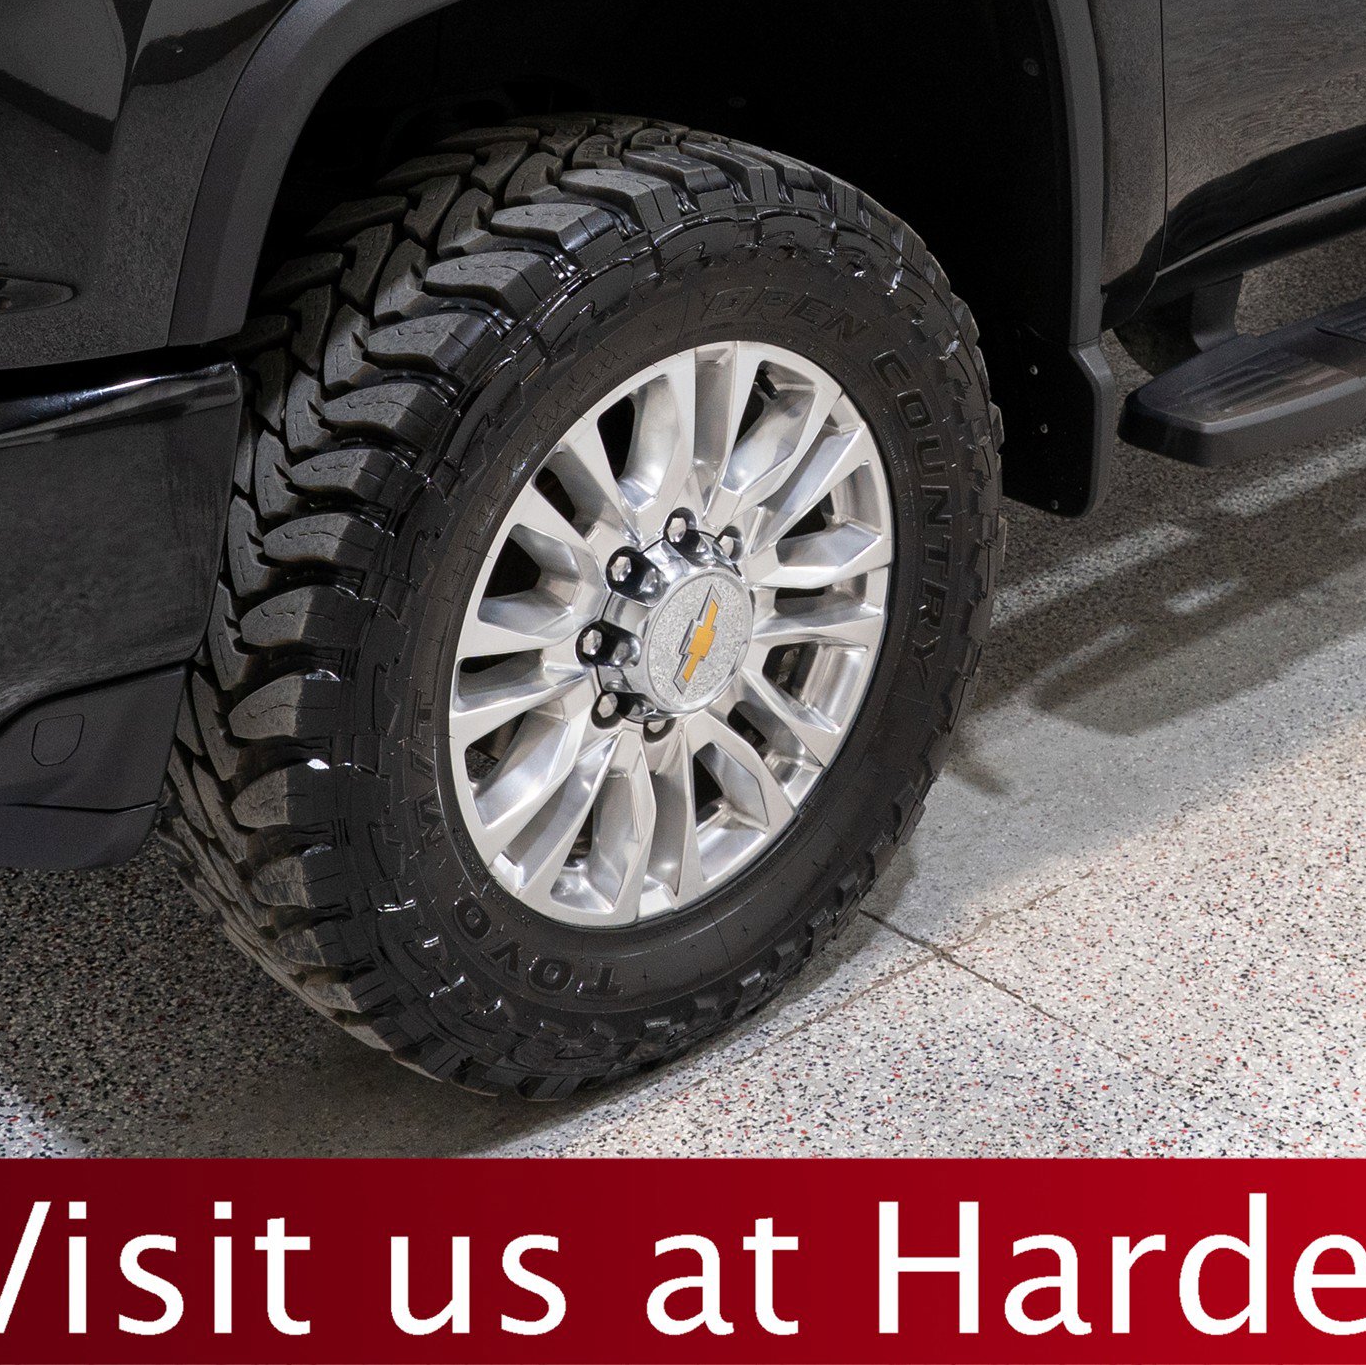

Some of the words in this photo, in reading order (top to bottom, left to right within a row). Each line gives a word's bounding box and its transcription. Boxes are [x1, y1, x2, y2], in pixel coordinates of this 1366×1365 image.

[699, 286, 868, 342] OPEN
[870, 348, 953, 691] COUNTRY
[453, 896, 624, 997] TOYO
